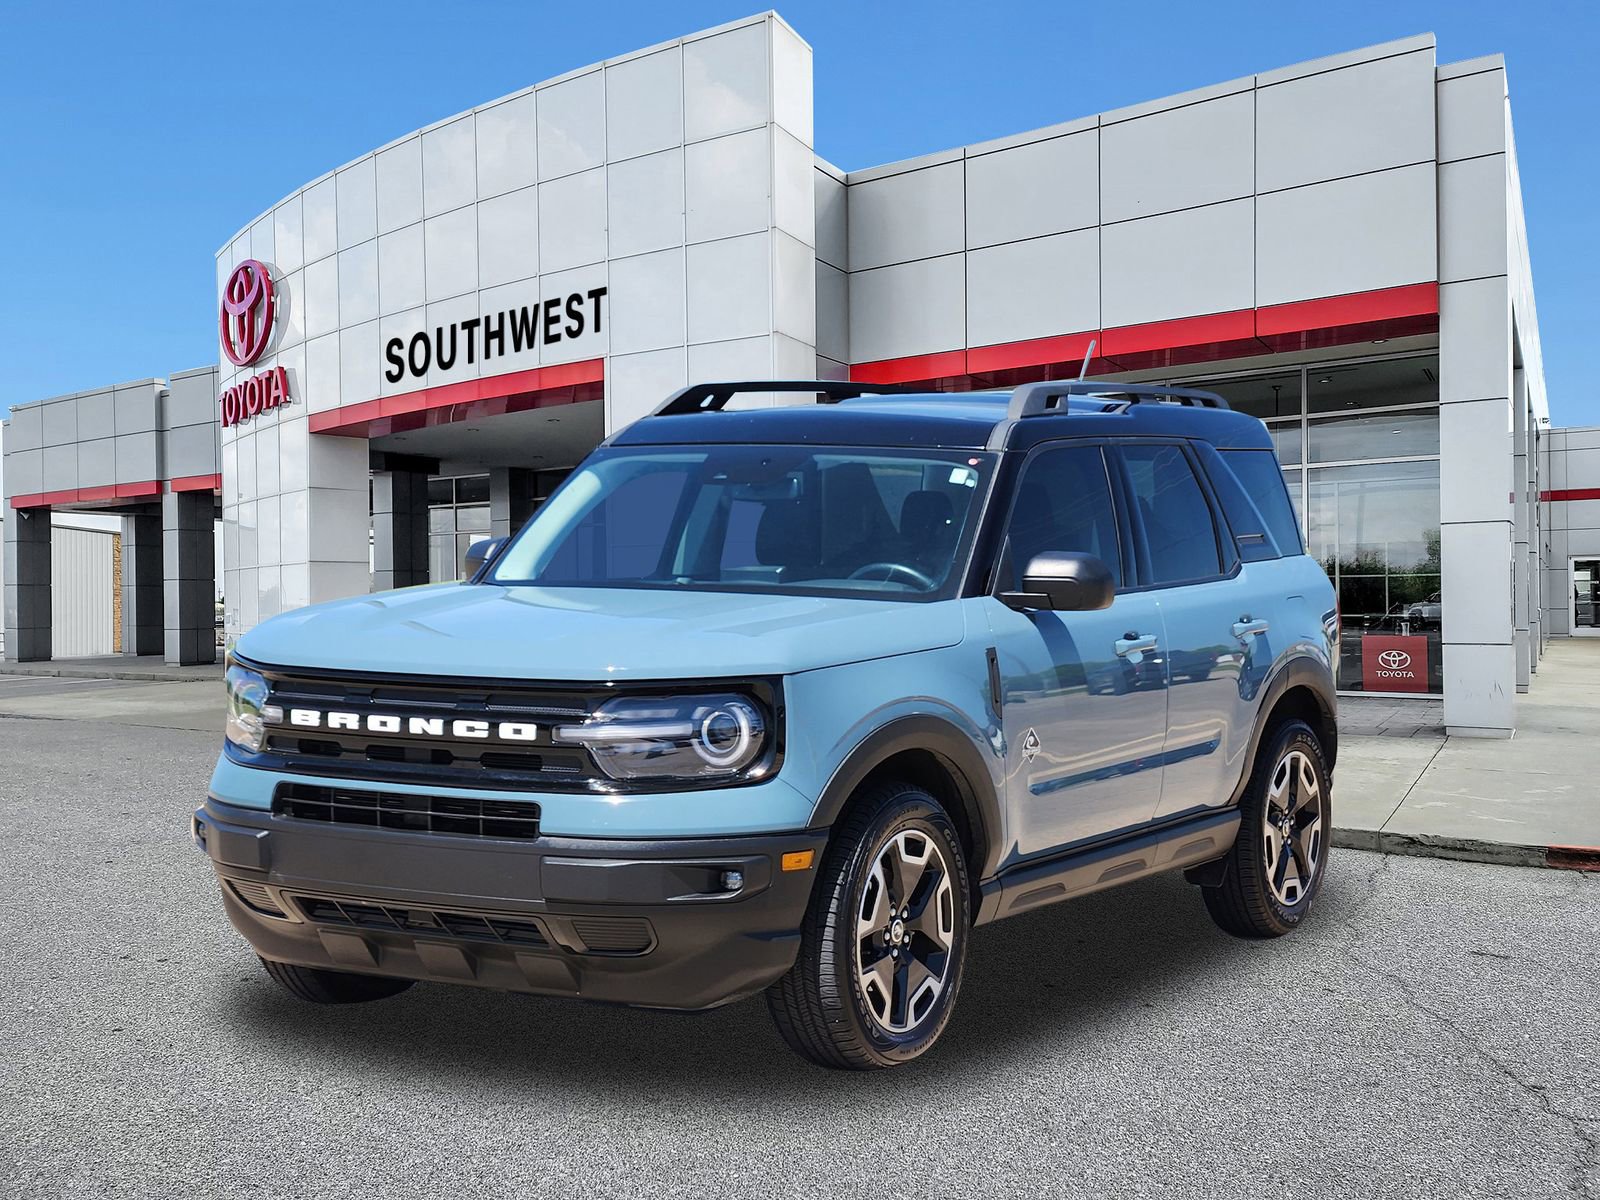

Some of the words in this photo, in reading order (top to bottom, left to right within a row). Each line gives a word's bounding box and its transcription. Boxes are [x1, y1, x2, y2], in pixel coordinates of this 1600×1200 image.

[385, 286, 608, 384] SOUTHWEST
[217, 366, 291, 428] TOYOTA
[1375, 670, 1415, 678] TOYOTA
[290, 709, 538, 741] BRONCO
